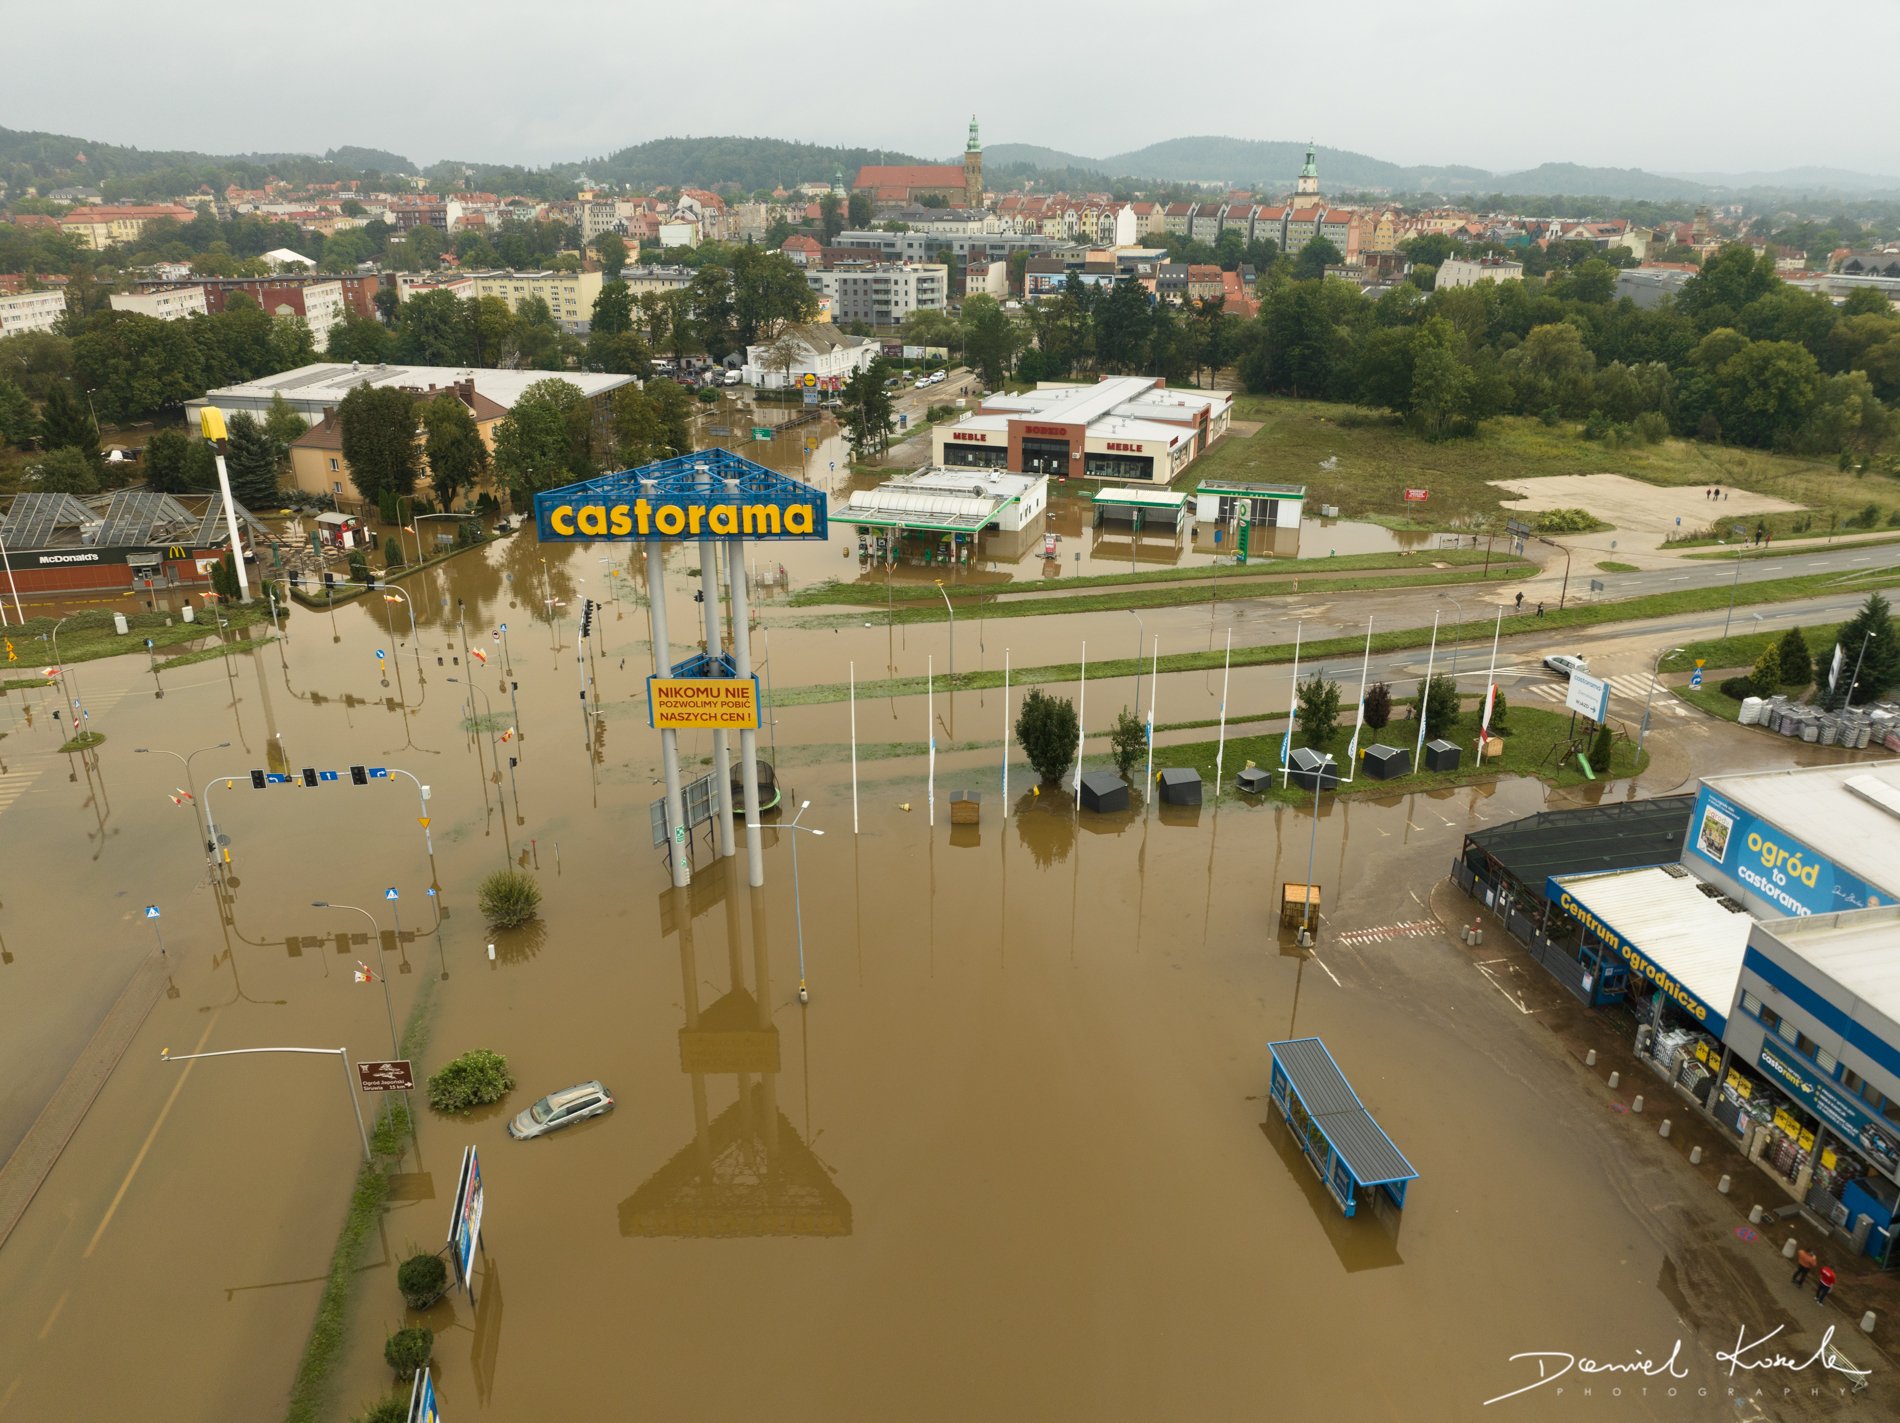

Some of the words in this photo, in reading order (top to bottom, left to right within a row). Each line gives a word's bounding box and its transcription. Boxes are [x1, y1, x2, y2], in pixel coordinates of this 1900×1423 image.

[953, 432, 986, 442] MEBLE
[1107, 442, 1143, 452] MEBLE
[550, 499, 814, 536] castorama
[39, 553, 99, 564] McDonald's
[658, 687, 720, 698] NIKOMU
[725, 687, 750, 698] NIE
[721, 699, 751, 708] POBIĆ
[660, 712, 717, 721] NASZYCH
[720, 712, 745, 721] CEN
[1747, 832, 1820, 888] ogród
[1772, 867, 1786, 886] to
[1738, 865, 1812, 917] castorama
[1560, 893, 1619, 950] Centrum
[1621, 946, 1707, 1021] ogrodnicze
[1761, 1052, 1799, 1087] castorent
